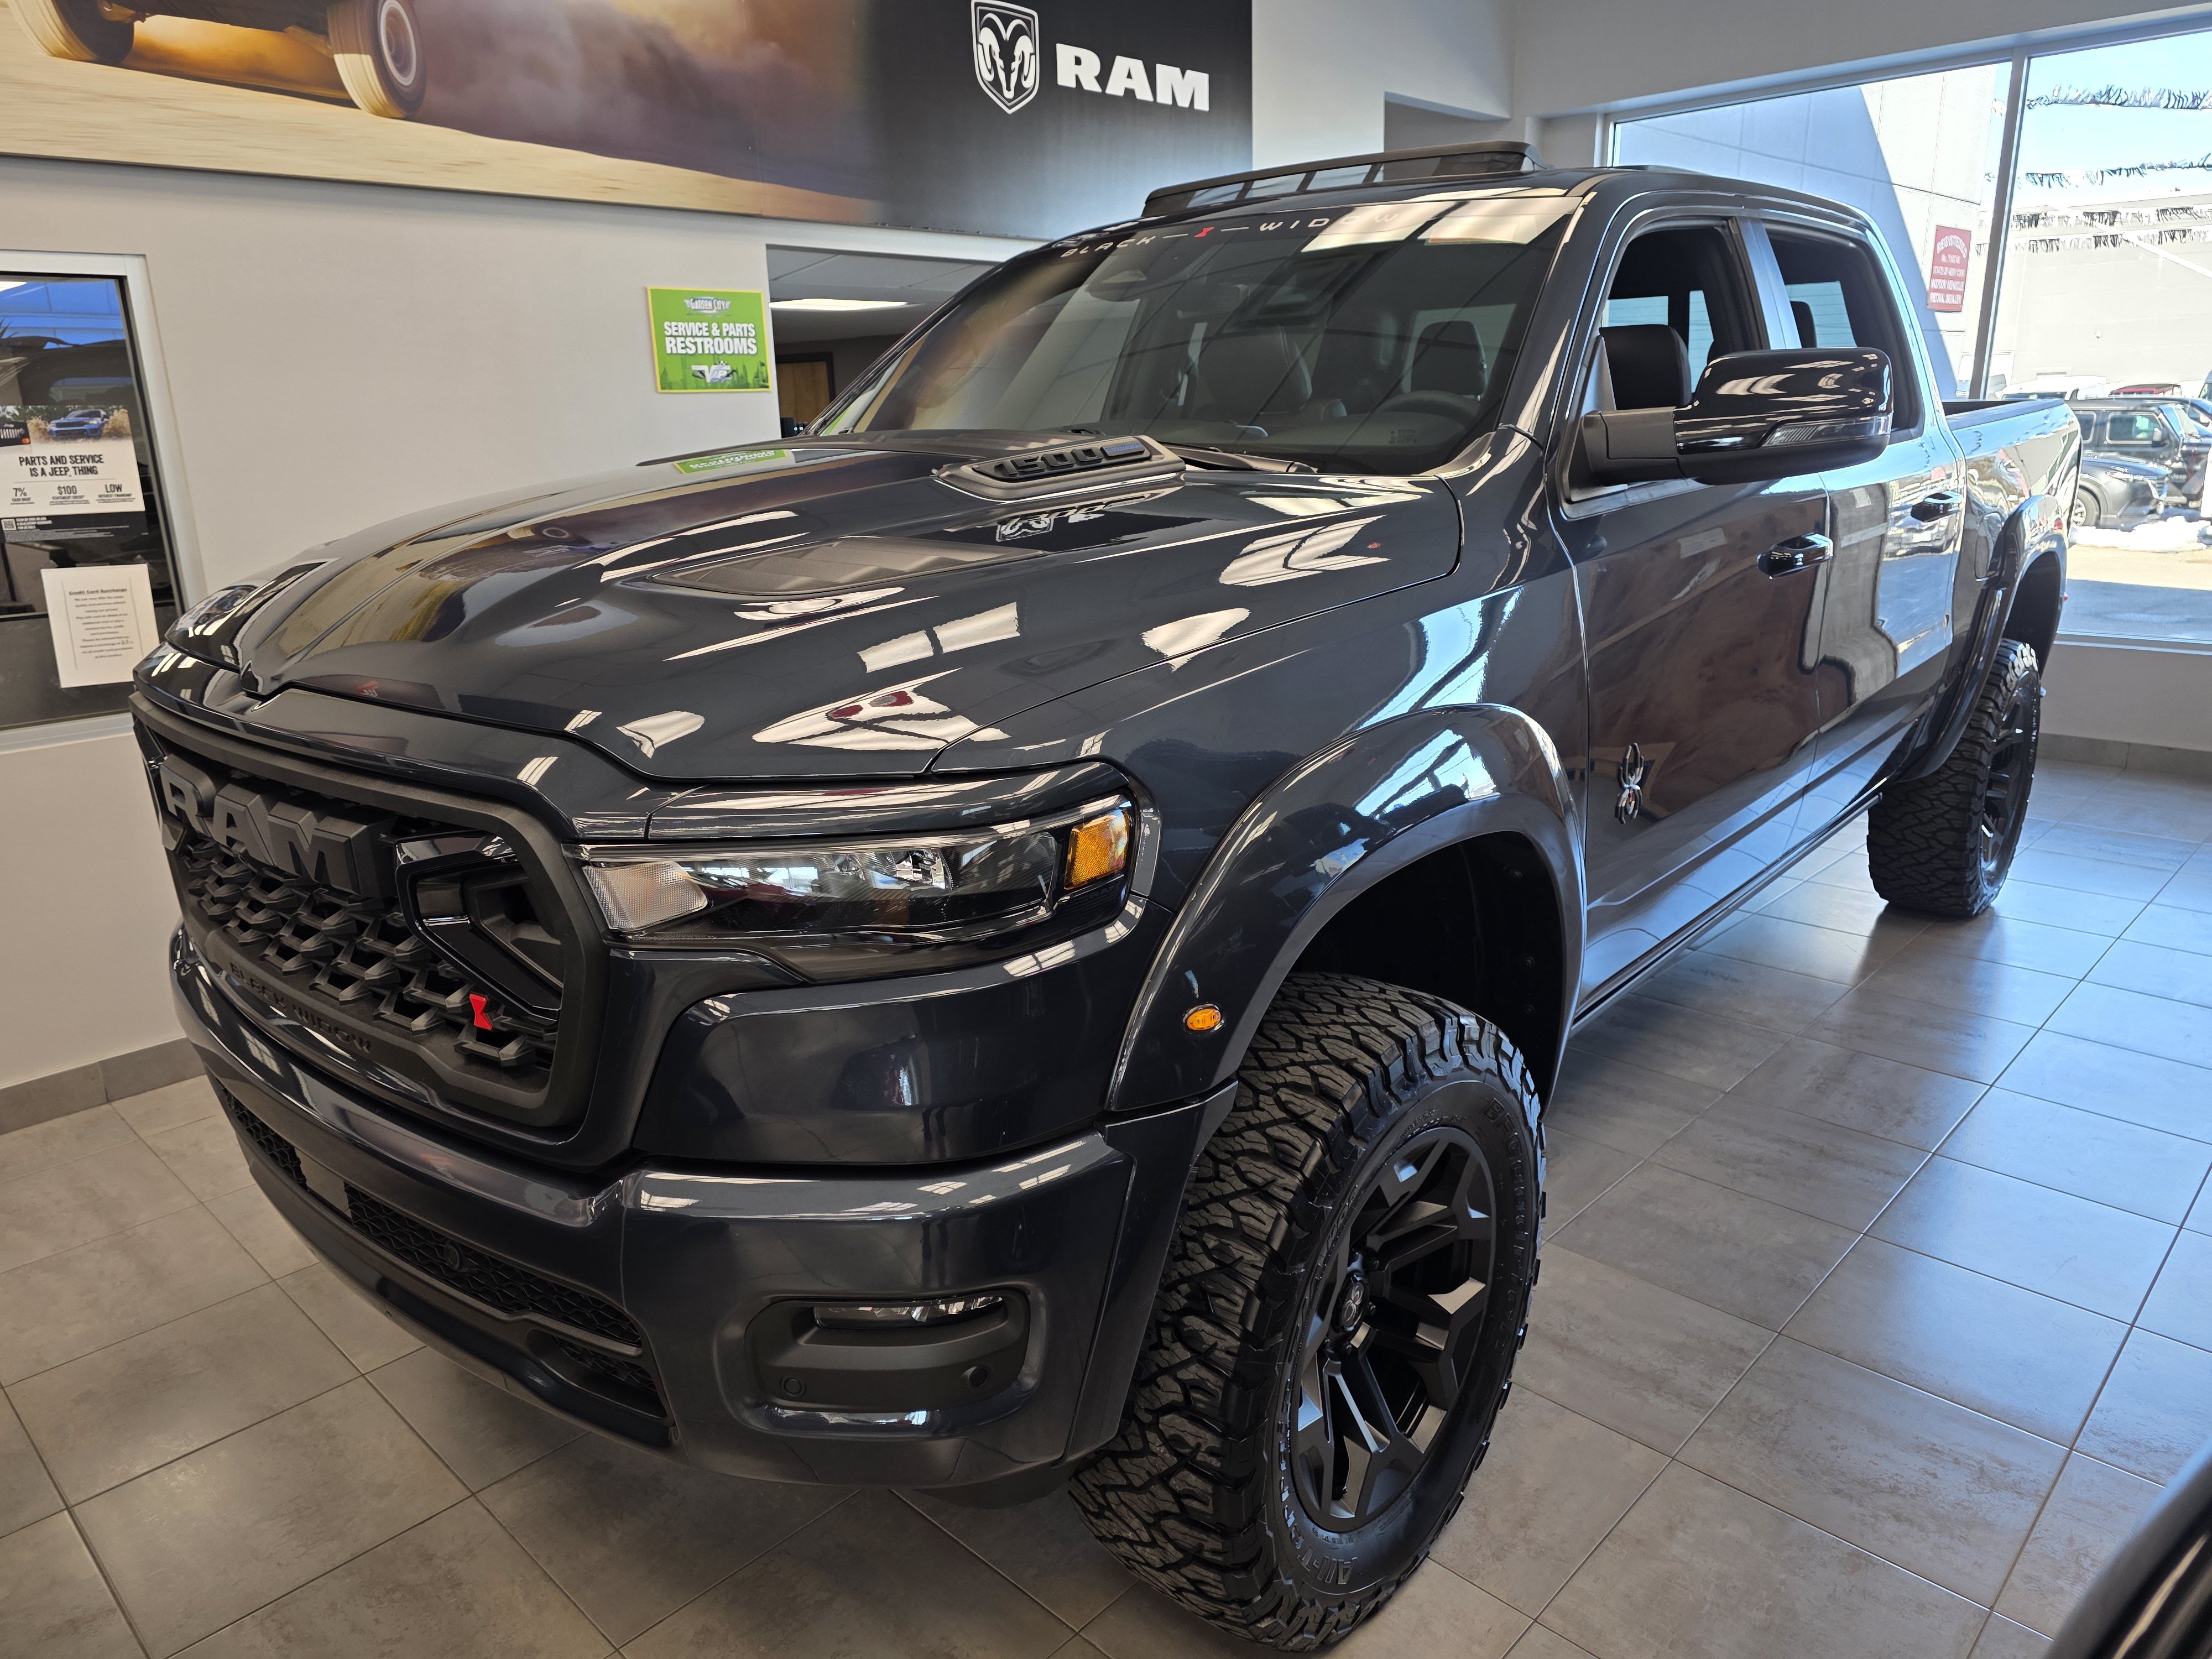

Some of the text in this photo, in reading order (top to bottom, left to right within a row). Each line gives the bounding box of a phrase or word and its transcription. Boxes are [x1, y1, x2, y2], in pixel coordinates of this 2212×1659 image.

[1055, 43, 1210, 112] RAM
[1061, 211, 1401, 258] BLACK WIDOW
[664, 321, 755, 337] SERVICE & PARTS
[665, 337, 758, 354] RESTROOMS
[19, 454, 105, 466] PARTS AND SERVICE
[29, 466, 98, 477] IS A JEEP THING
[994, 447, 1104, 478] 1500
[13, 484, 123, 497] 7% $100 LOW
[160, 753, 373, 897] RAM
[229, 962, 372, 1054] BLACK WIDOW
